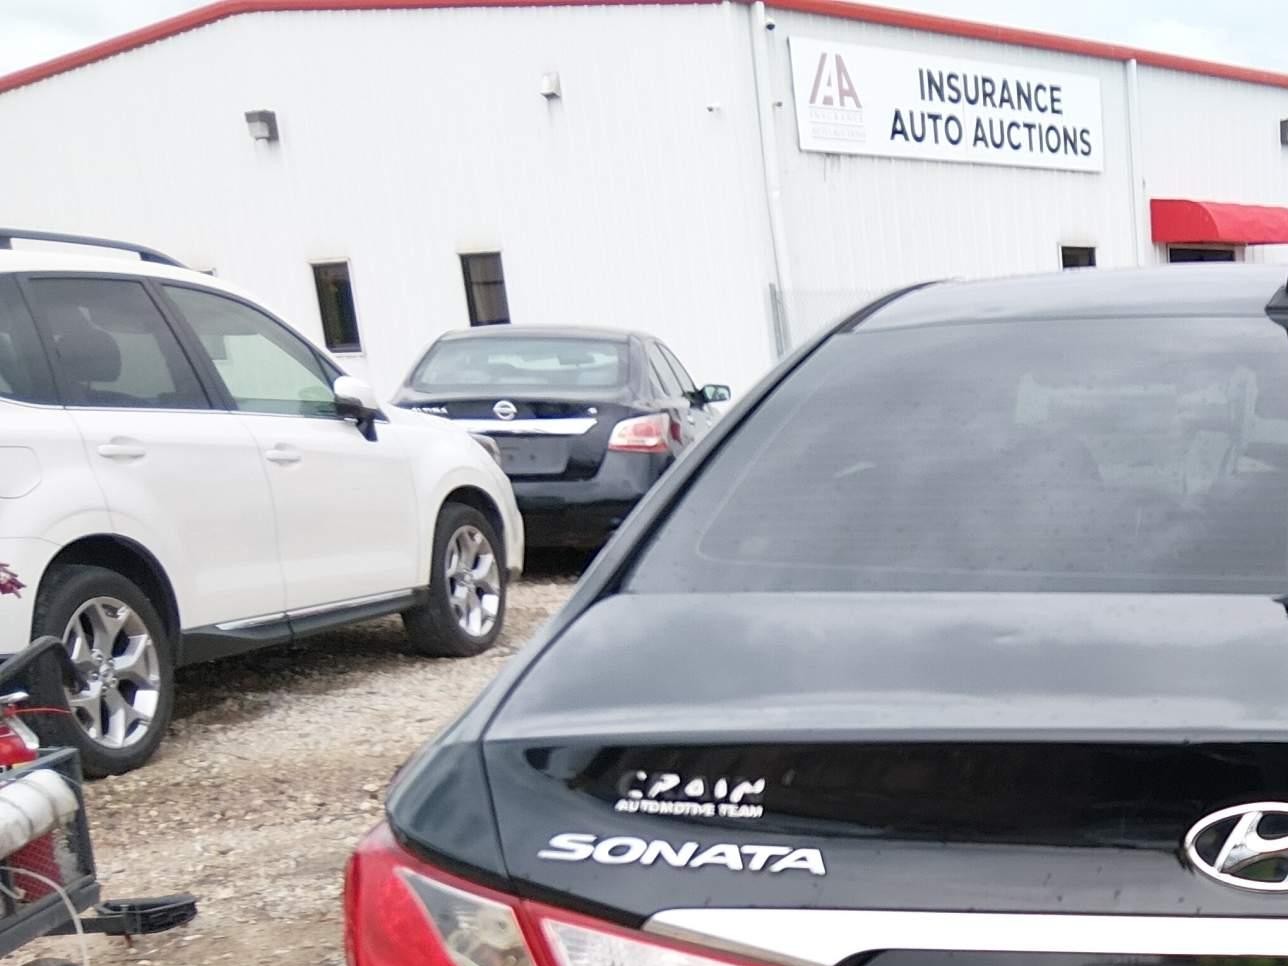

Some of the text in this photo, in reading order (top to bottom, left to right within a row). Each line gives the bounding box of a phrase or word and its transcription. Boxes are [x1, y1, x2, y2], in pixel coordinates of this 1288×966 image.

[917, 68, 1064, 116] INSURANCE
[890, 108, 1092, 157] AUTO AUCTIONS
[614, 798, 764, 818] AUTOMOTIVE TEAM
[537, 832, 827, 876] SONATA
